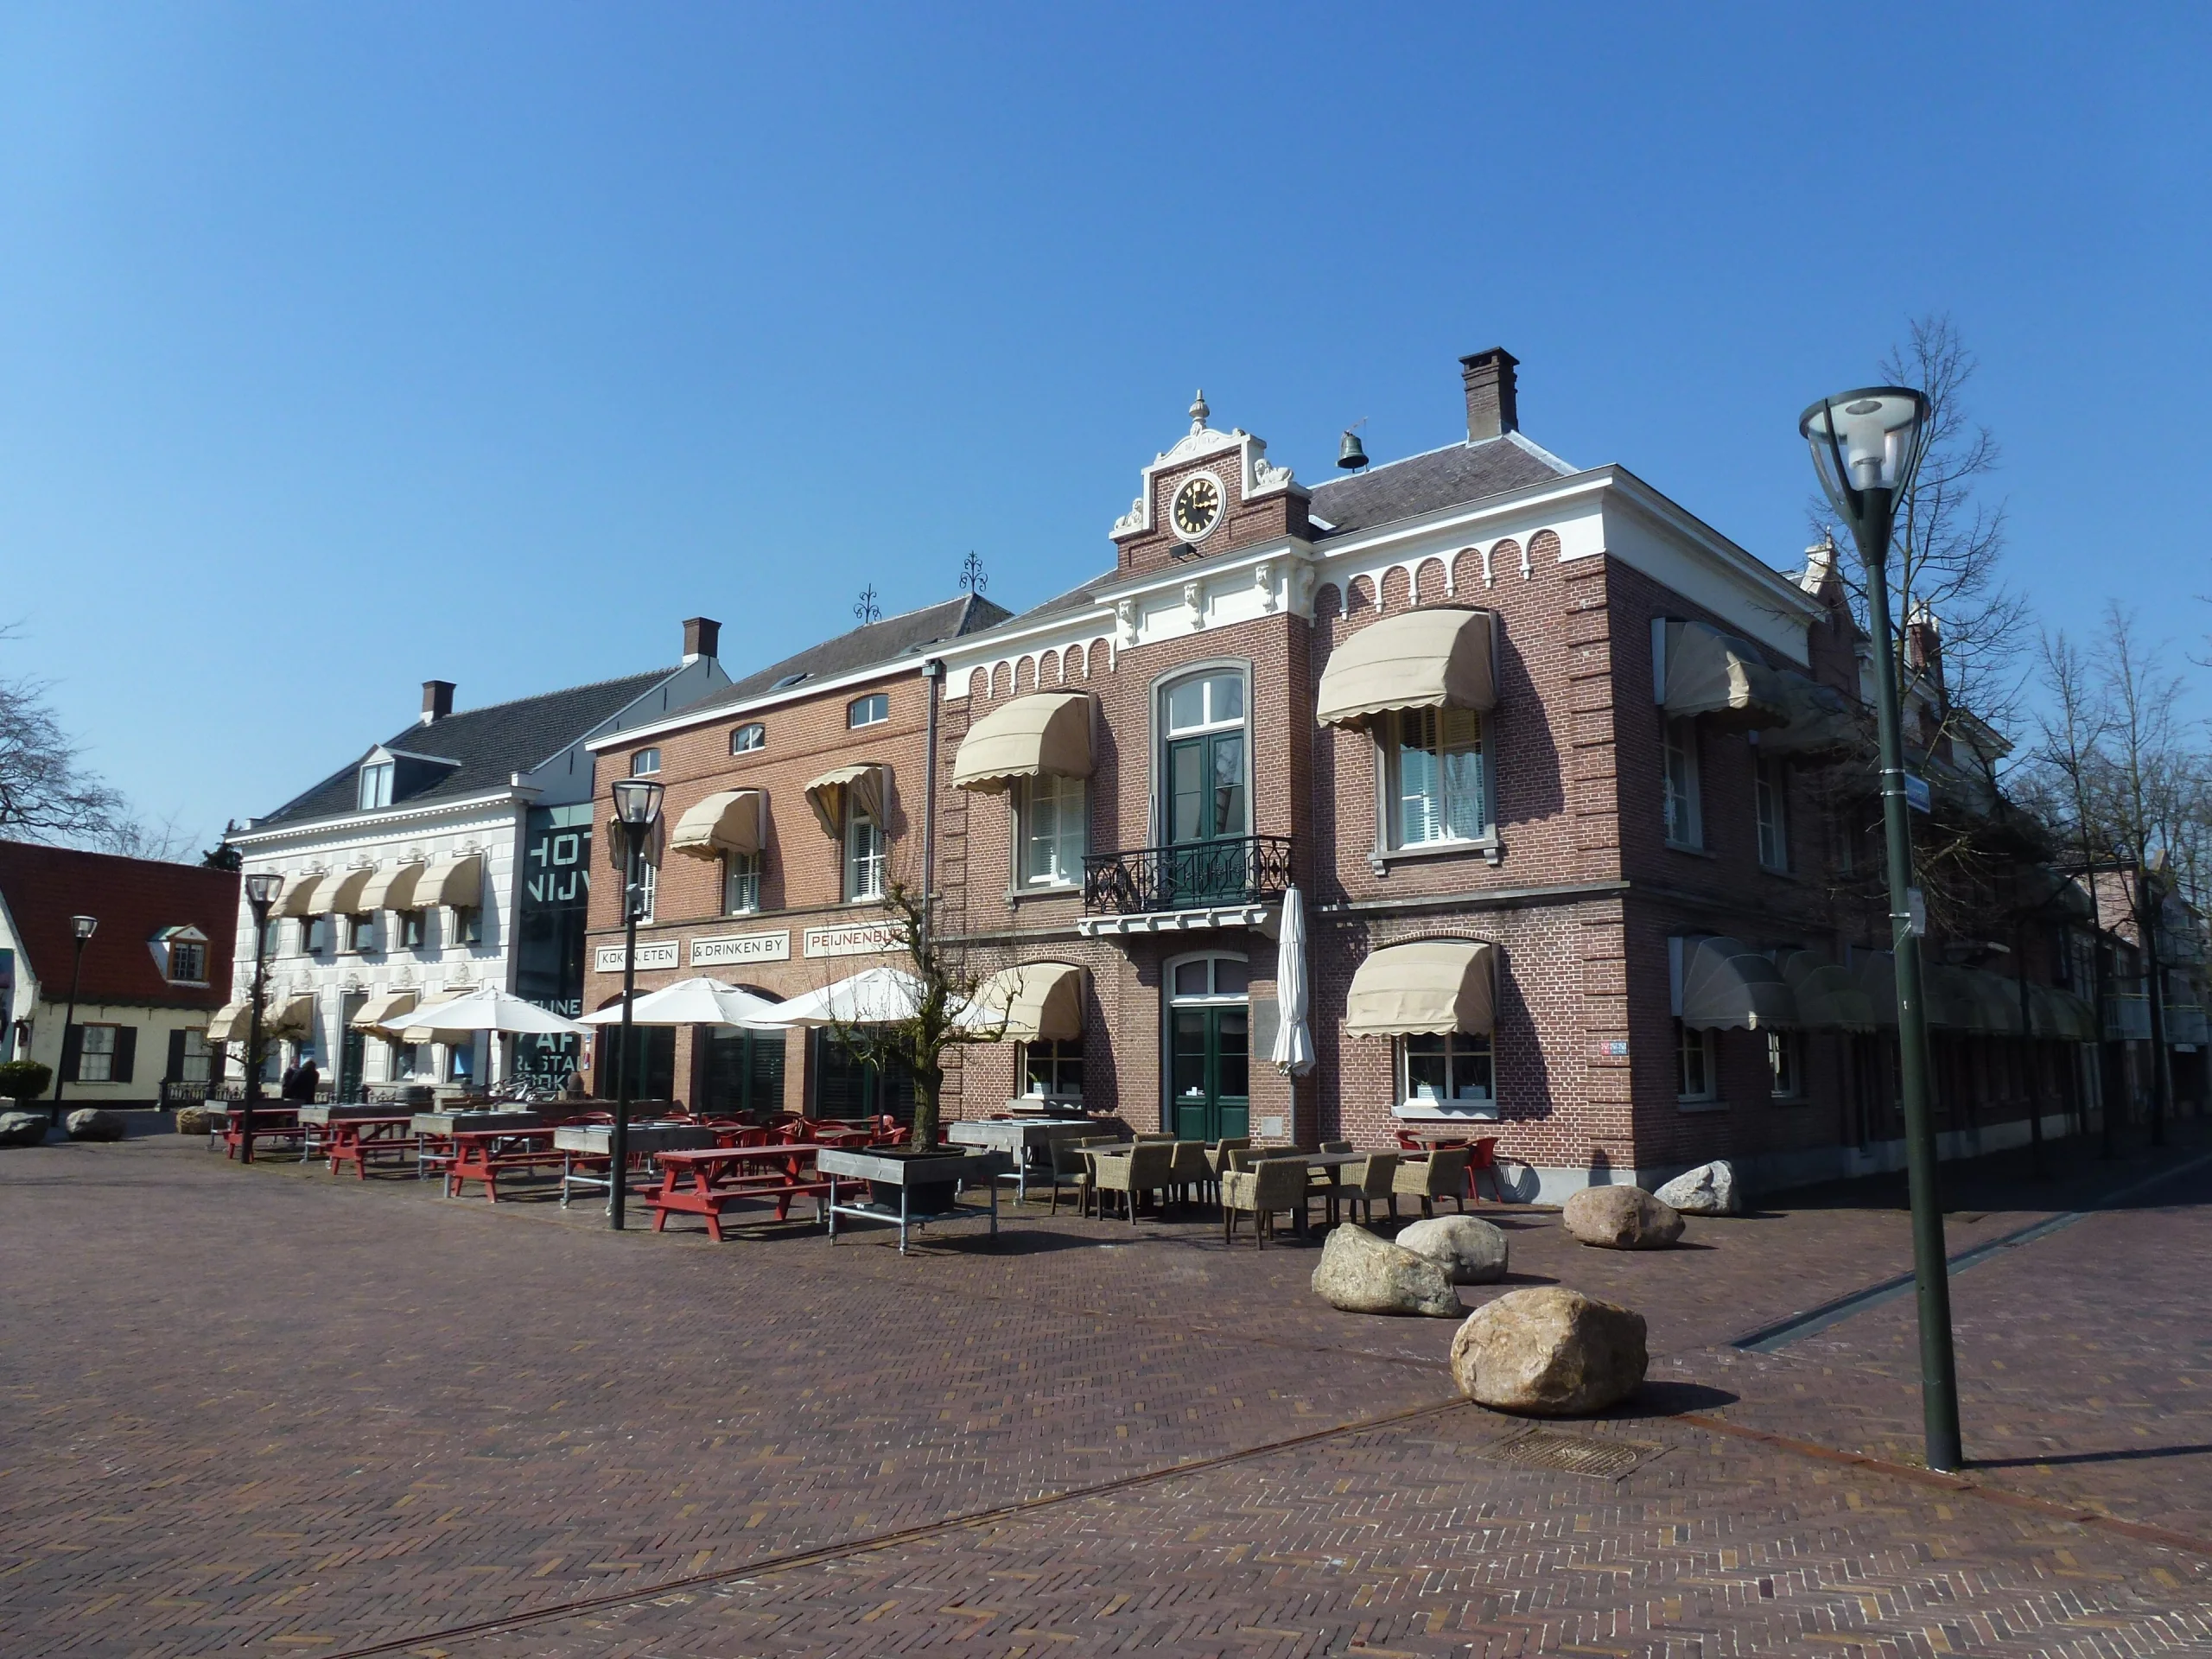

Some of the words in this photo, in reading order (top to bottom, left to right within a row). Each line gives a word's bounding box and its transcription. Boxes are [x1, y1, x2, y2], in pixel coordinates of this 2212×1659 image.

[531, 832, 593, 867] HO
[643, 949, 673, 961] ETEN
[694, 946, 702, 957] &
[705, 941, 761, 957] DRINKEN
[766, 939, 783, 951] BY
